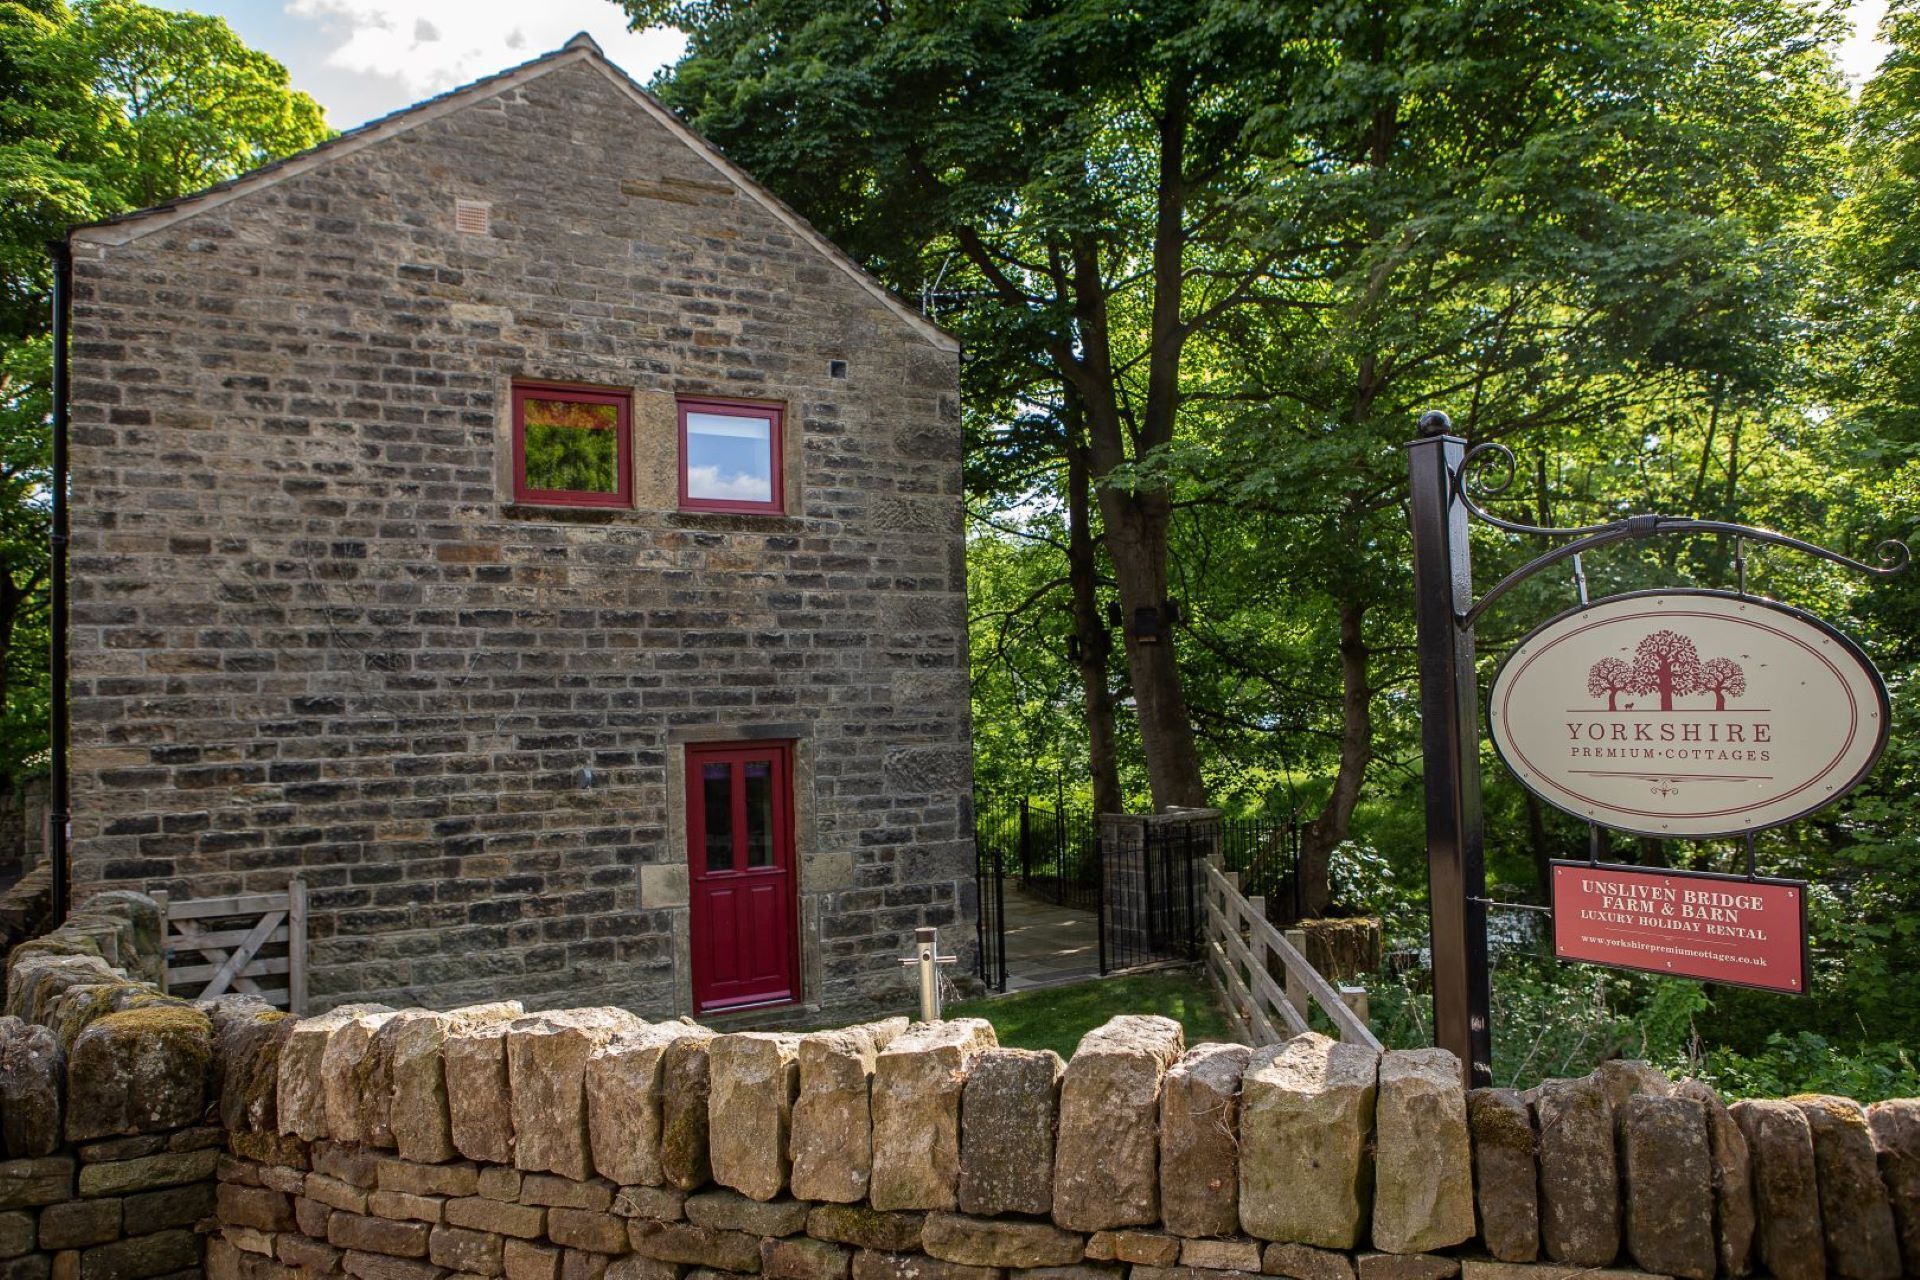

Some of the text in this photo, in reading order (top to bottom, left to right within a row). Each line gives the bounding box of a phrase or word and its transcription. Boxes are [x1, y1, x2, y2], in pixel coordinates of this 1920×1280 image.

[1566, 723, 1772, 742] YORKSHIRE
[1581, 880, 1763, 911] UNSLIVEN BRIDGE
[1602, 896, 1738, 923] FARM & BARN
[1581, 909, 1767, 941] LUXURY HOLIDAY RENTAL
[1581, 935, 1768, 967] www.yorkshirepremiumcottages.co.uk
